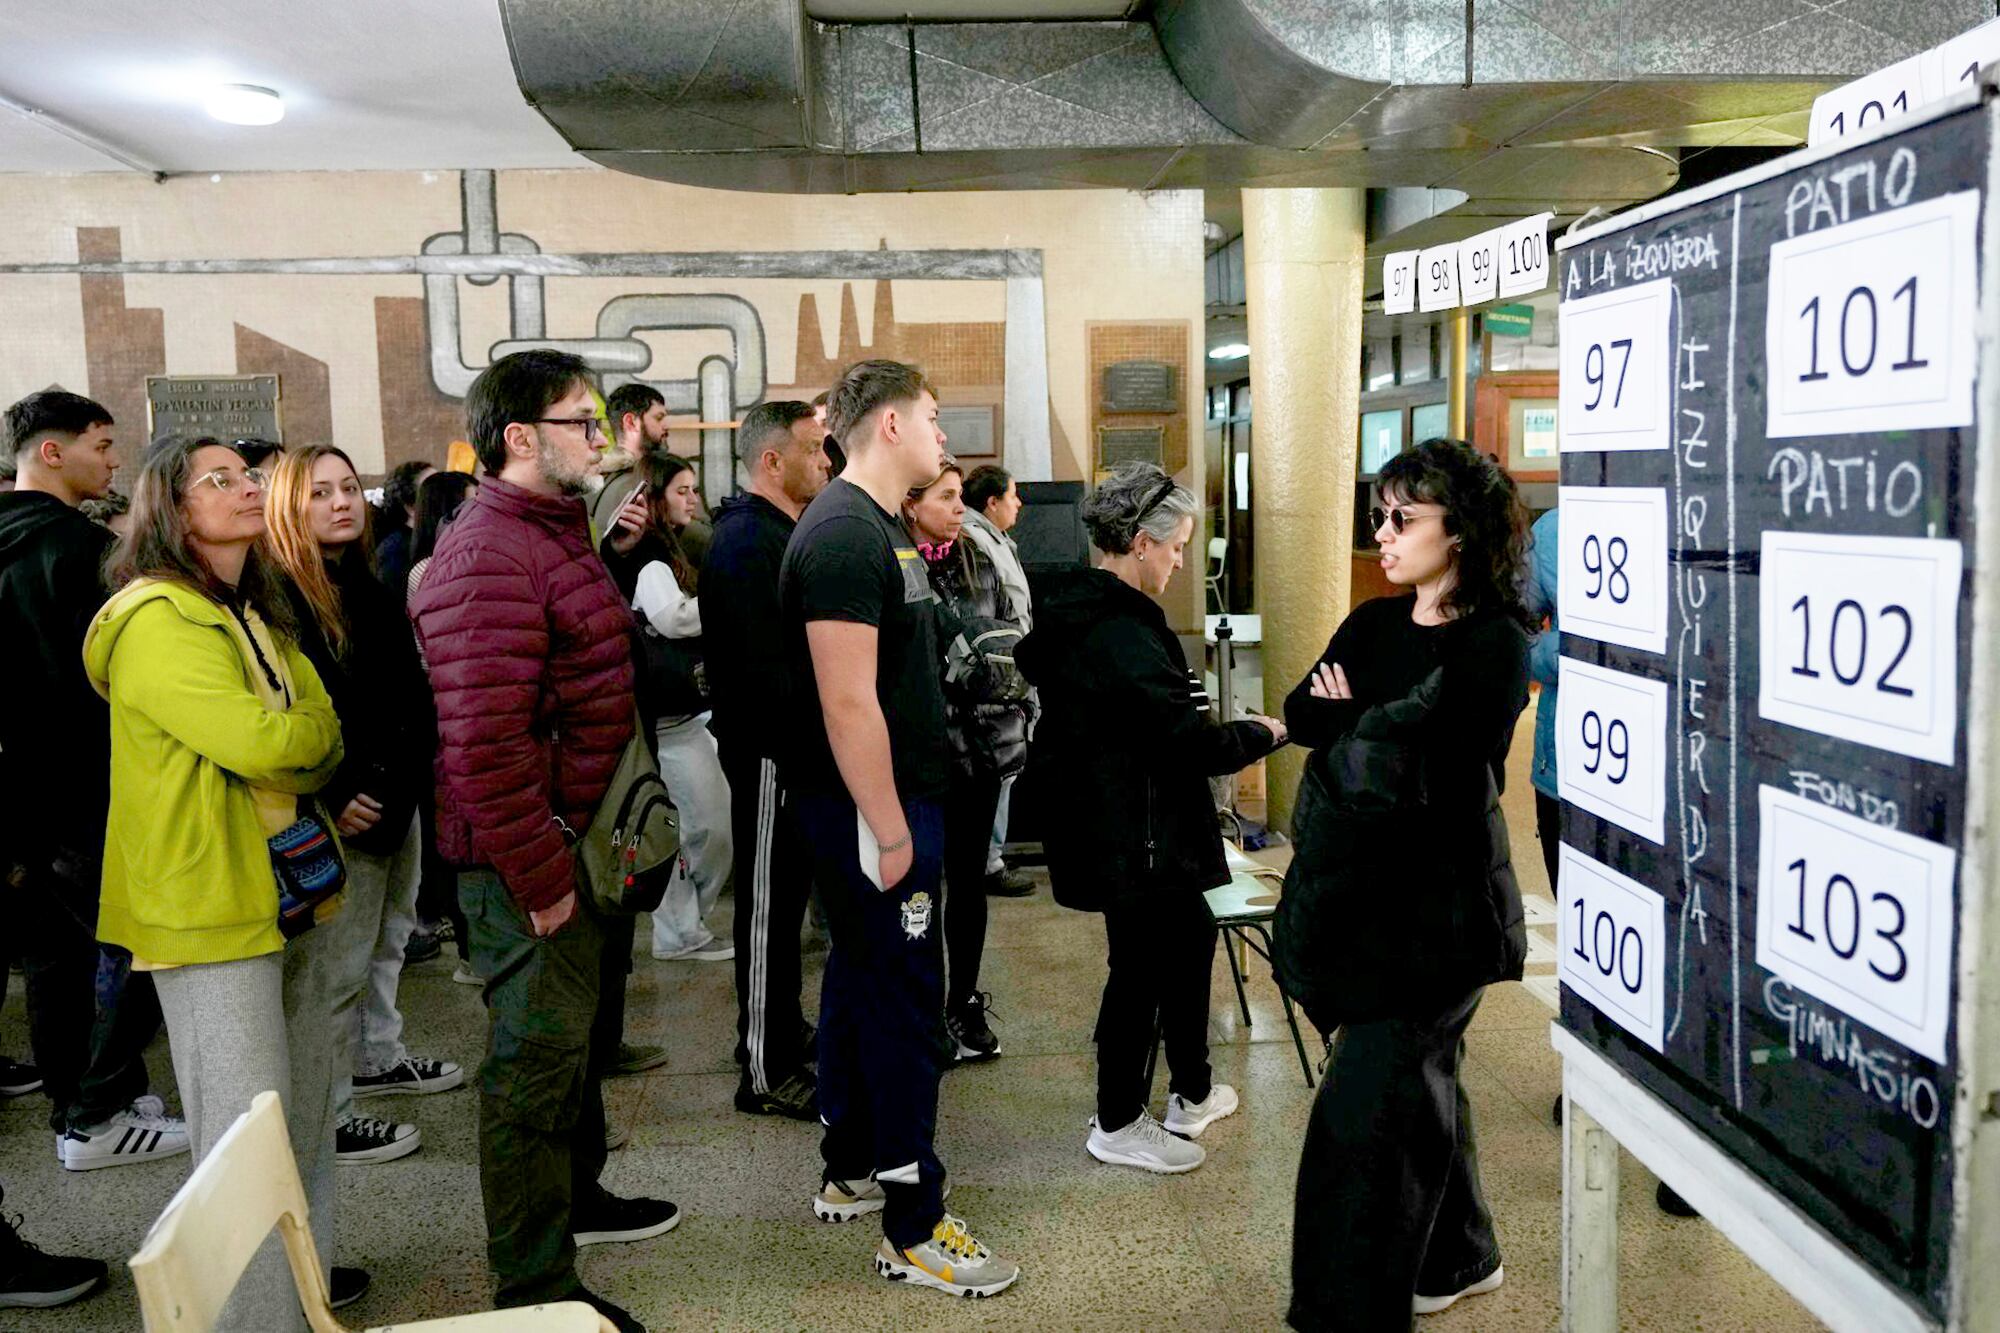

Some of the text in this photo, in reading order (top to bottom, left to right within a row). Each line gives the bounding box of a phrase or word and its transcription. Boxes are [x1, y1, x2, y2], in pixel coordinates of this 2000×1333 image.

[1394, 266, 1407, 296] 97
[1431, 259, 1449, 292] 98
[1472, 248, 1490, 284] 99
[1508, 233, 1542, 275] 100
[1565, 258, 1581, 302] A
[1590, 249, 1616, 287] LA
[1799, 276, 1929, 383] 101
[1585, 338, 1633, 411] 97
[1583, 534, 1629, 604] 98
[1791, 595, 1914, 698] 102
[1582, 710, 1629, 785] 99
[1788, 770, 1899, 831] FONDO
[1573, 898, 1643, 994] 100
[1787, 858, 1908, 983] 103
